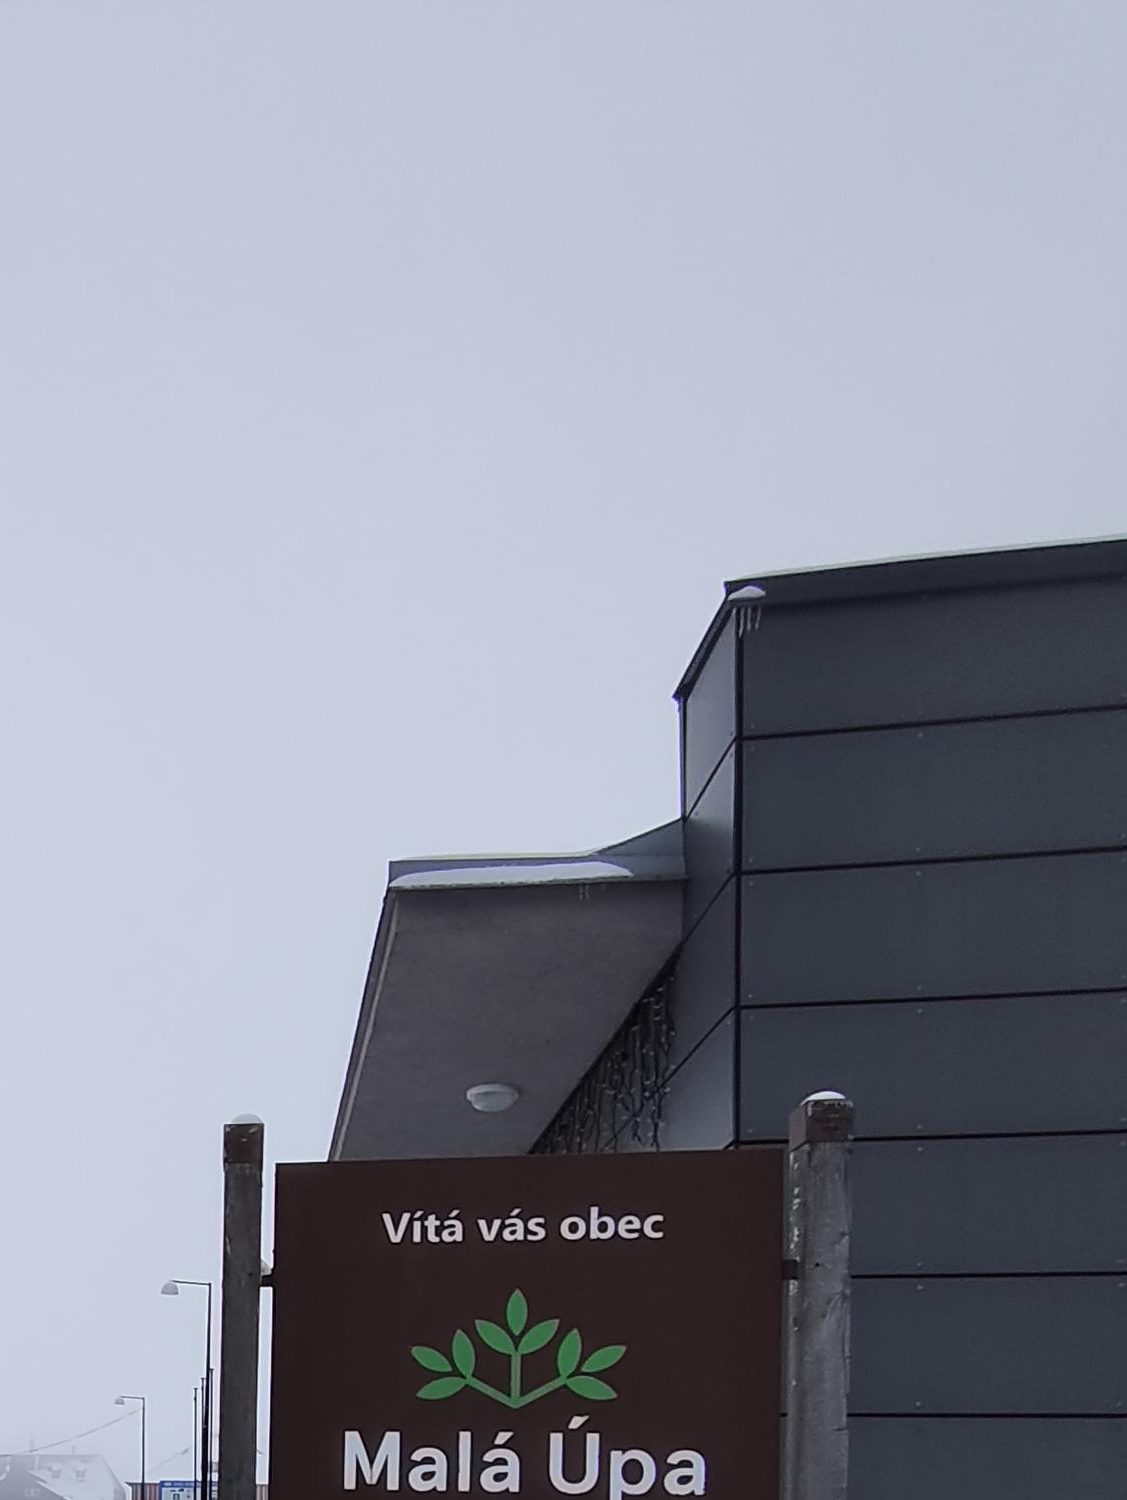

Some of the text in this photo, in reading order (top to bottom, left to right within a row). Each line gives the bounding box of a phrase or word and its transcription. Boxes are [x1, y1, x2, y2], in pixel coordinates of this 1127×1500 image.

[381, 1205, 665, 1244] Vítá vás obec
[342, 1429, 521, 1494] Malá
